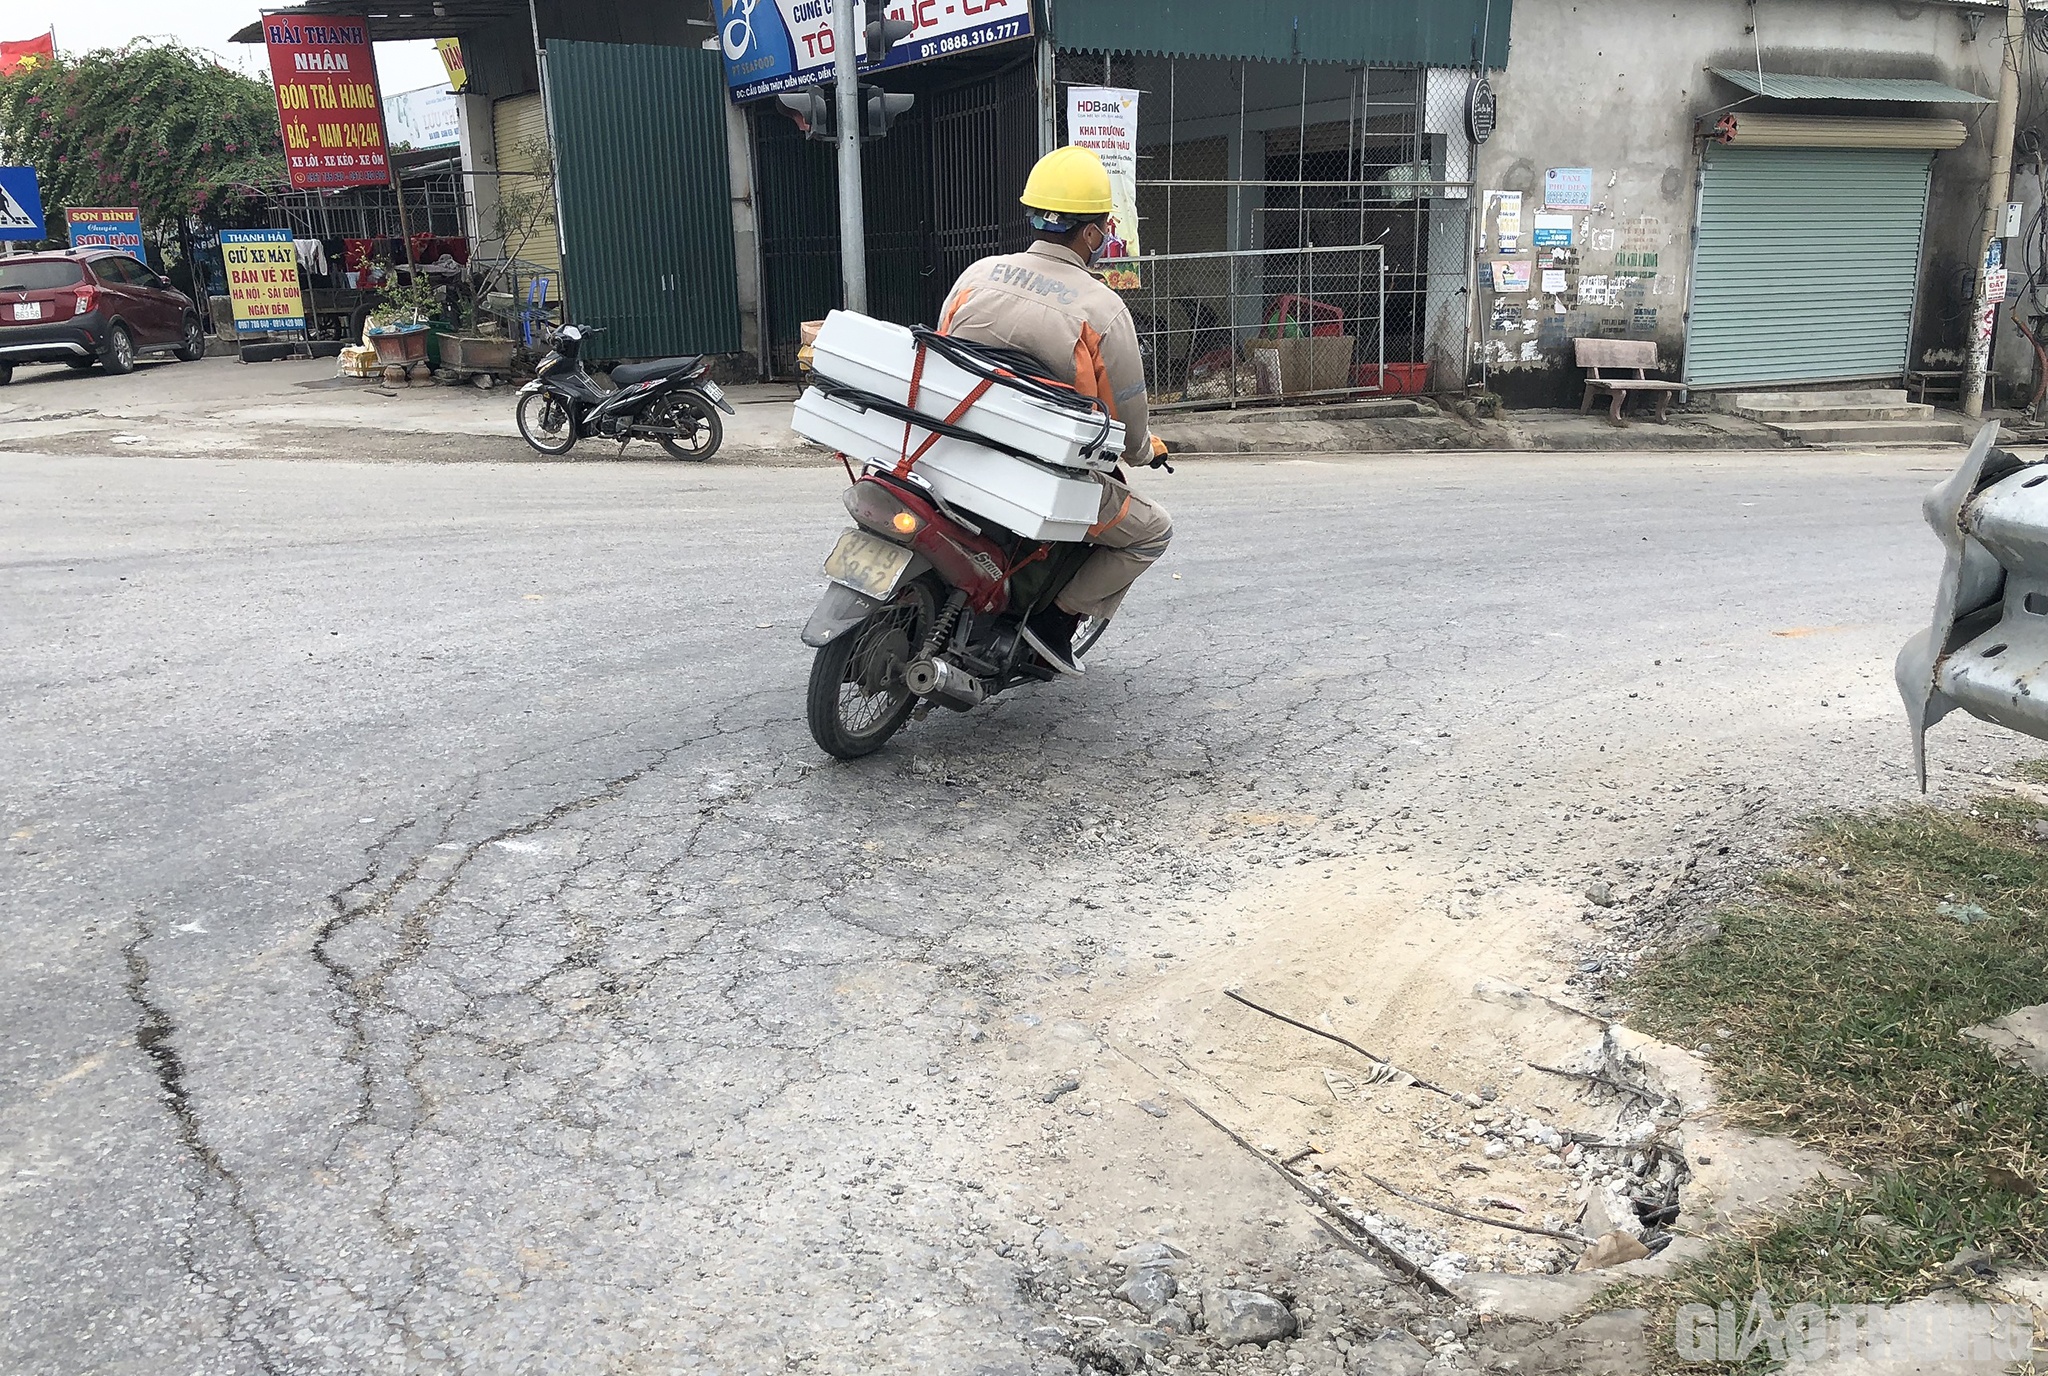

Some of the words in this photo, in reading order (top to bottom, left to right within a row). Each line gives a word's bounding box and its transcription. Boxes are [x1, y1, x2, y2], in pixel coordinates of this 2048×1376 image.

[793, 0, 821, 23] CUNG
[269, 18, 302, 44] HẢI
[304, 26, 364, 45] THANH
[921, 44, 938, 57] ĐT:
[940, 22, 1019, 53] 0888.316.777
[801, 22, 835, 58] TÔ
[294, 49, 349, 73] NHẬN
[741, 55, 775, 75] SEAFOOD
[279, 78, 309, 109] ĐÓN
[310, 77, 338, 109] TRẢ
[339, 78, 375, 109] HÀNG
[1077, 100, 1120, 113] HDBank
[287, 115, 309, 148] BẮC
[318, 123, 343, 147] NAM
[344, 122, 380, 149] 24/24H
[1079, 126, 1097, 135] KHAI
[1116, 139, 1130, 150] HÂU
[291, 156, 304, 167] XE
[305, 153, 319, 167] LÔI
[324, 155, 336, 166] XE
[338, 152, 354, 166] KÉO
[359, 155, 370, 165] XE
[371, 152, 384, 165] ÔM
[72, 211, 98, 221] SƠN
[101, 210, 135, 221] BÌNH
[76, 234, 106, 246] SƠN
[109, 232, 140, 246] HÀN
[228, 234, 265, 242] THANH
[268, 232, 286, 241] HẢI
[228, 246, 248, 263] GIỮ
[250, 250, 266, 263] XE
[267, 246, 291, 263] MÁY
[232, 267, 259, 283] BÁN
[280, 269, 297, 282] XE
[232, 287, 244, 300] HÀ
[246, 286, 260, 301] NỘI
[267, 286, 281, 299] SÀI
[283, 285, 300, 298] GÒN
[248, 302, 269, 316] NGÀY
[271, 302, 290, 315] ĐÊM
